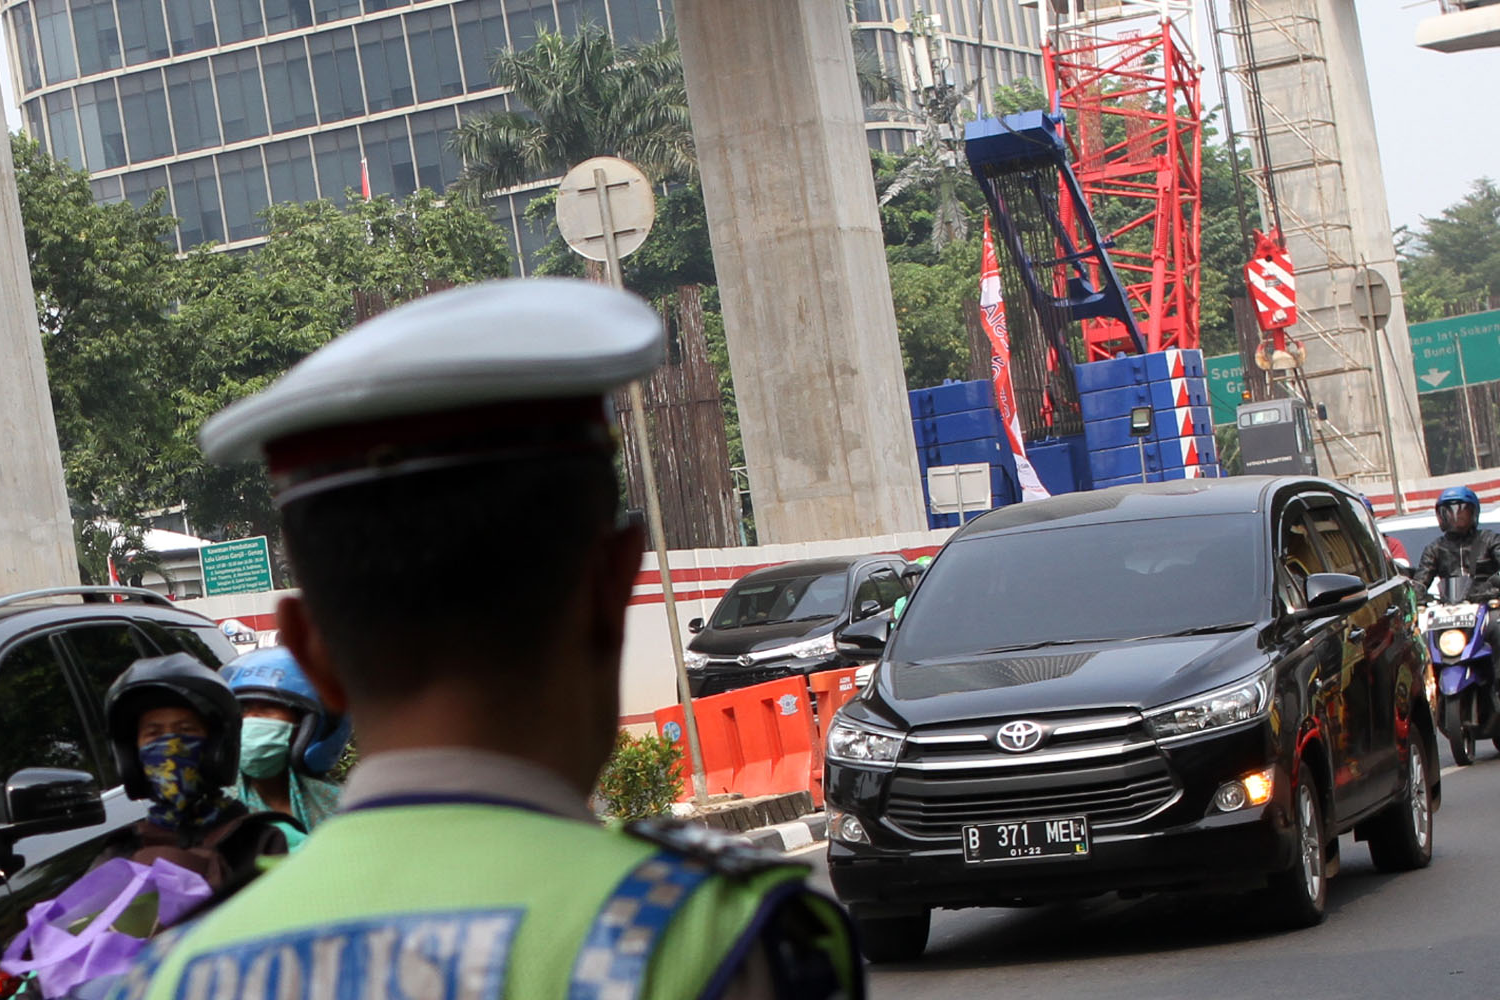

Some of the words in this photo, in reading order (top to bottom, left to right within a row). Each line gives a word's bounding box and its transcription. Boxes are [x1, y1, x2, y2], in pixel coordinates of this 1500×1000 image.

[968, 828, 980, 849] B
[997, 823, 1029, 847] 371
[1045, 820, 1082, 843] MEL
